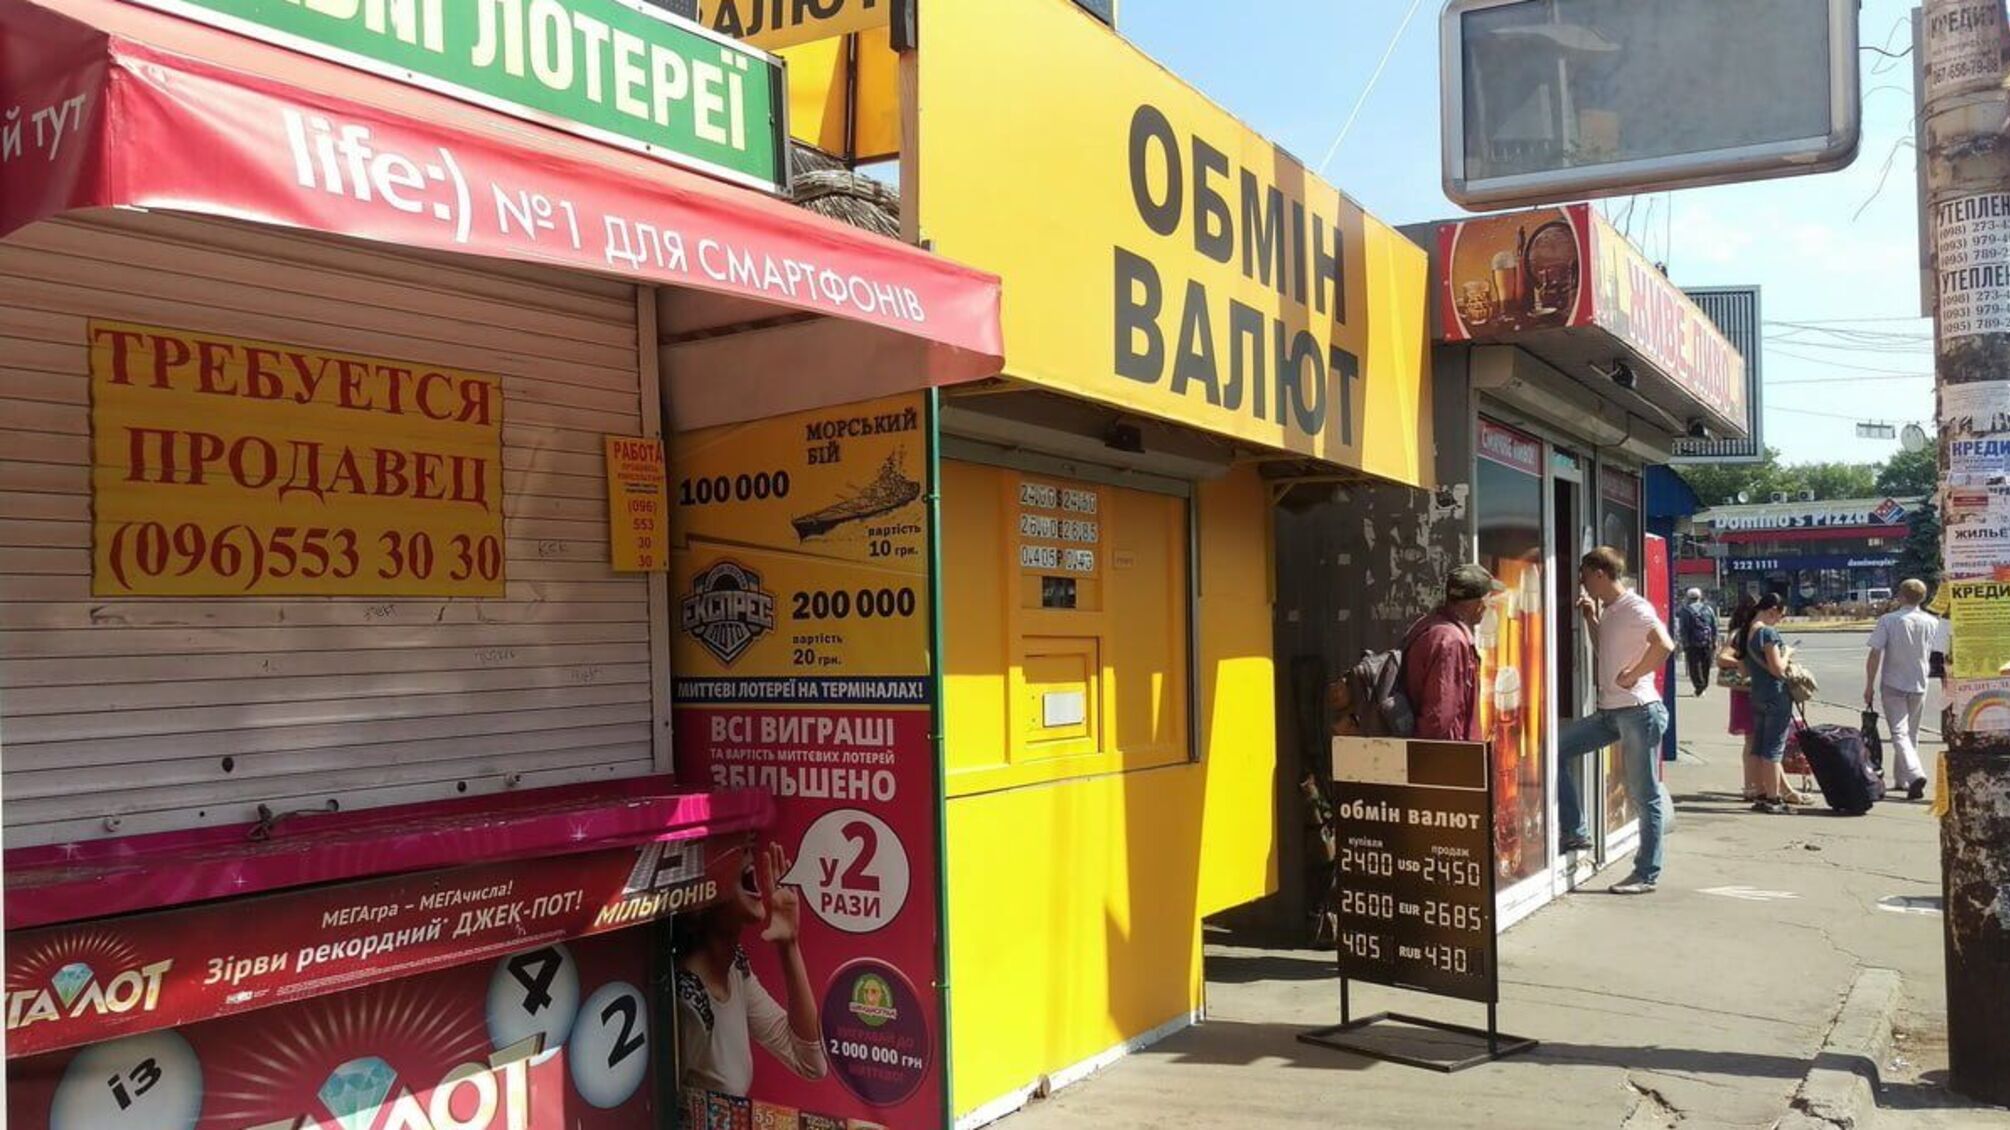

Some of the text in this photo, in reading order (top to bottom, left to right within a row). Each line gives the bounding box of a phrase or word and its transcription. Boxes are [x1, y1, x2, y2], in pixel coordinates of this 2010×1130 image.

[472, 0, 746, 151] ЛОТЕРЕЇ
[282, 108, 472, 243] life:)
[1129, 104, 1346, 326] ОБМІН
[491, 182, 926, 323] №1 ДЛЯ СМАРТФОНІВ
[1114, 245, 1359, 447] ВАЛЮТ
[94, 328, 492, 426] ТРЕБУЕТСЯ
[806, 407, 918, 441] МОРСЬКИЙ
[123, 426, 489, 514] ПРОДАВЕЦ
[613, 440, 664, 464] РАБОТА
[807, 440, 841, 465] БІЙ
[680, 475, 731, 507] 100
[735, 469, 790, 501] 000
[868, 523, 921, 537] вартість
[1714, 509, 1869, 530] Domino's Pizza
[109, 522, 500, 590] (096)553 30 30
[869, 540, 891, 557] 10
[1733, 560, 1778, 570] 222 1111
[792, 587, 916, 621] 200 000
[792, 632, 843, 646] вартість
[793, 649, 815, 666] 20
[678, 678, 924, 699] МИТТЄВІ ЛОТЕРЕЇ НА ТЕРМІНАЛАХ!
[711, 715, 895, 746] ВСІ ВИГРАШІ
[711, 749, 895, 764] ТА ВАРТІСТЬ МИТТЄВИХ ЛОТЕРЕЙ
[711, 764, 897, 801] ЗБІЛЬШЕНО
[1340, 799, 1481, 830] обмін валют
[841, 820, 880, 891] 2
[1348, 836, 1470, 858] купівля продаж
[1341, 849, 1481, 887] 2400 USD 2450
[321, 880, 513, 930] МЕГАгра МЕГАчисла!
[594, 880, 718, 927] МІЛЬЙОНІВ
[820, 891, 881, 919] РАЗИ
[1341, 890, 1482, 931] 2600 EUR 2685
[203, 954, 287, 986] Зірви
[452, 889, 584, 938] ДЖЕК-ПОТ!
[1343, 932, 1467, 974] 405 RUB 430
[507, 945, 563, 1016] 4
[600, 994, 646, 1068] 2
[830, 1039, 923, 1069] 2 000 000 ГРН
